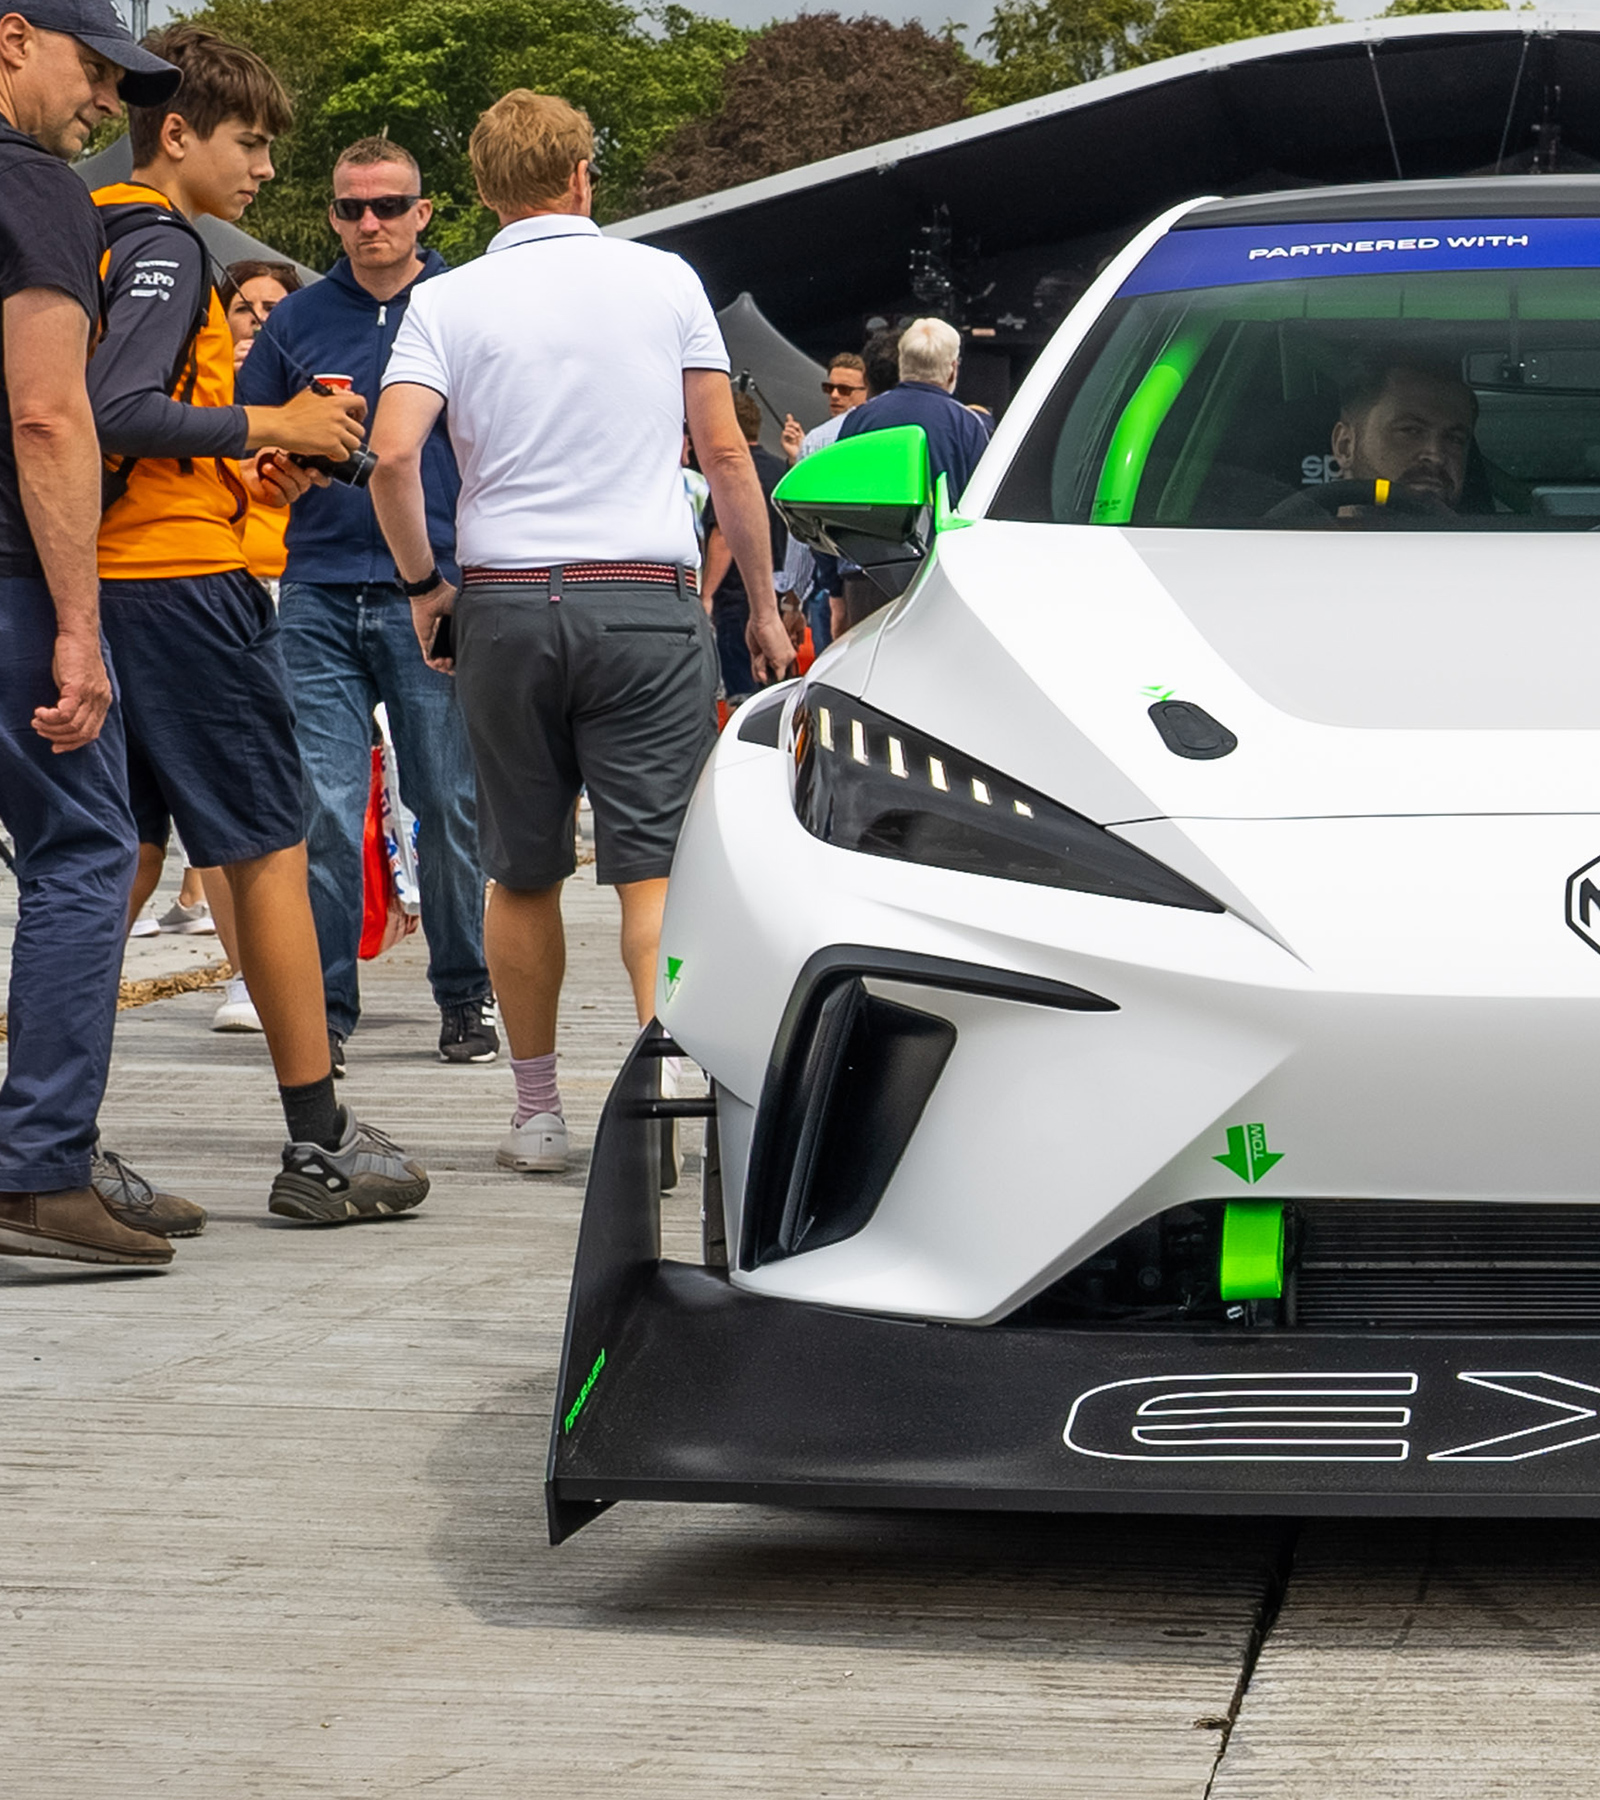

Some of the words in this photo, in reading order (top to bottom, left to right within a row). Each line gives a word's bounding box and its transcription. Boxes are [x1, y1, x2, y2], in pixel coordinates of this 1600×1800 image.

[1248, 238, 1440, 261] PARTNERED
[1446, 234, 1529, 248] WITH
[1250, 1124, 1265, 1161] TOW
